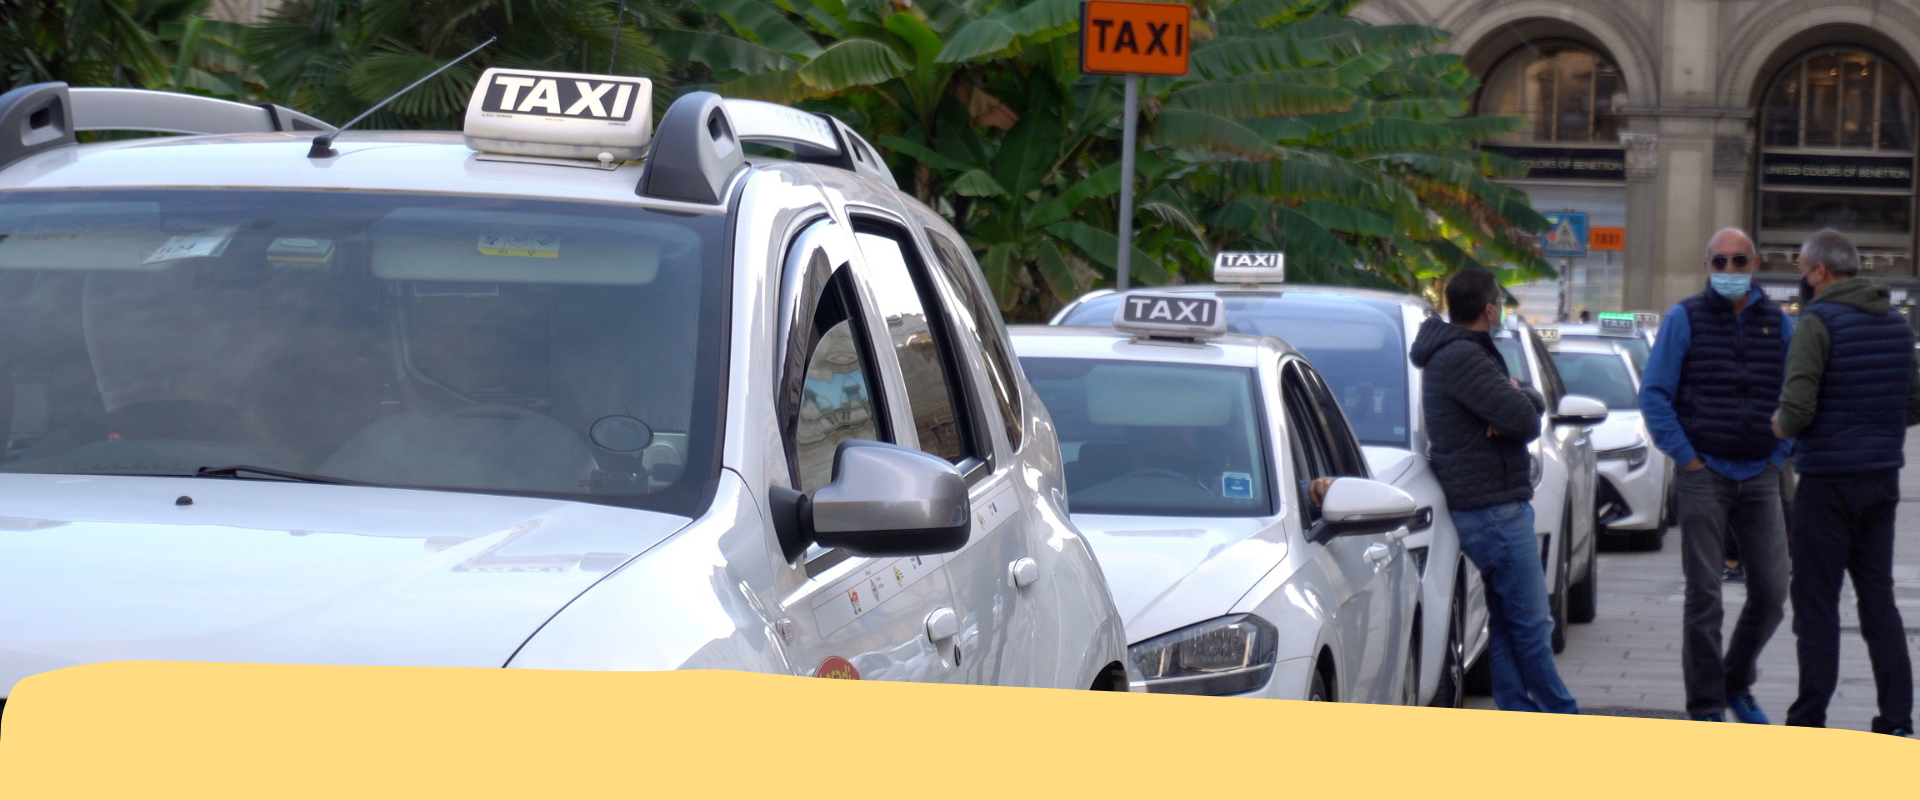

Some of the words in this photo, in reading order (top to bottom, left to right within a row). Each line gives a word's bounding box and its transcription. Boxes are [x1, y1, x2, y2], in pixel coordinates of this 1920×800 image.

[1091, 18, 1184, 57] TAXI
[495, 75, 633, 119] TAXI
[1558, 161, 1572, 170] OF
[1765, 165, 1801, 176] UNITED
[1803, 166, 1842, 177] COLORS
[1844, 167, 1858, 178] OF
[1224, 254, 1277, 267] TAXI
[1129, 298, 1211, 323] TAXI
[1603, 319, 1632, 329] TAXI
[1635, 314, 1655, 324] AXI
[1537, 329, 1558, 339] AXI
